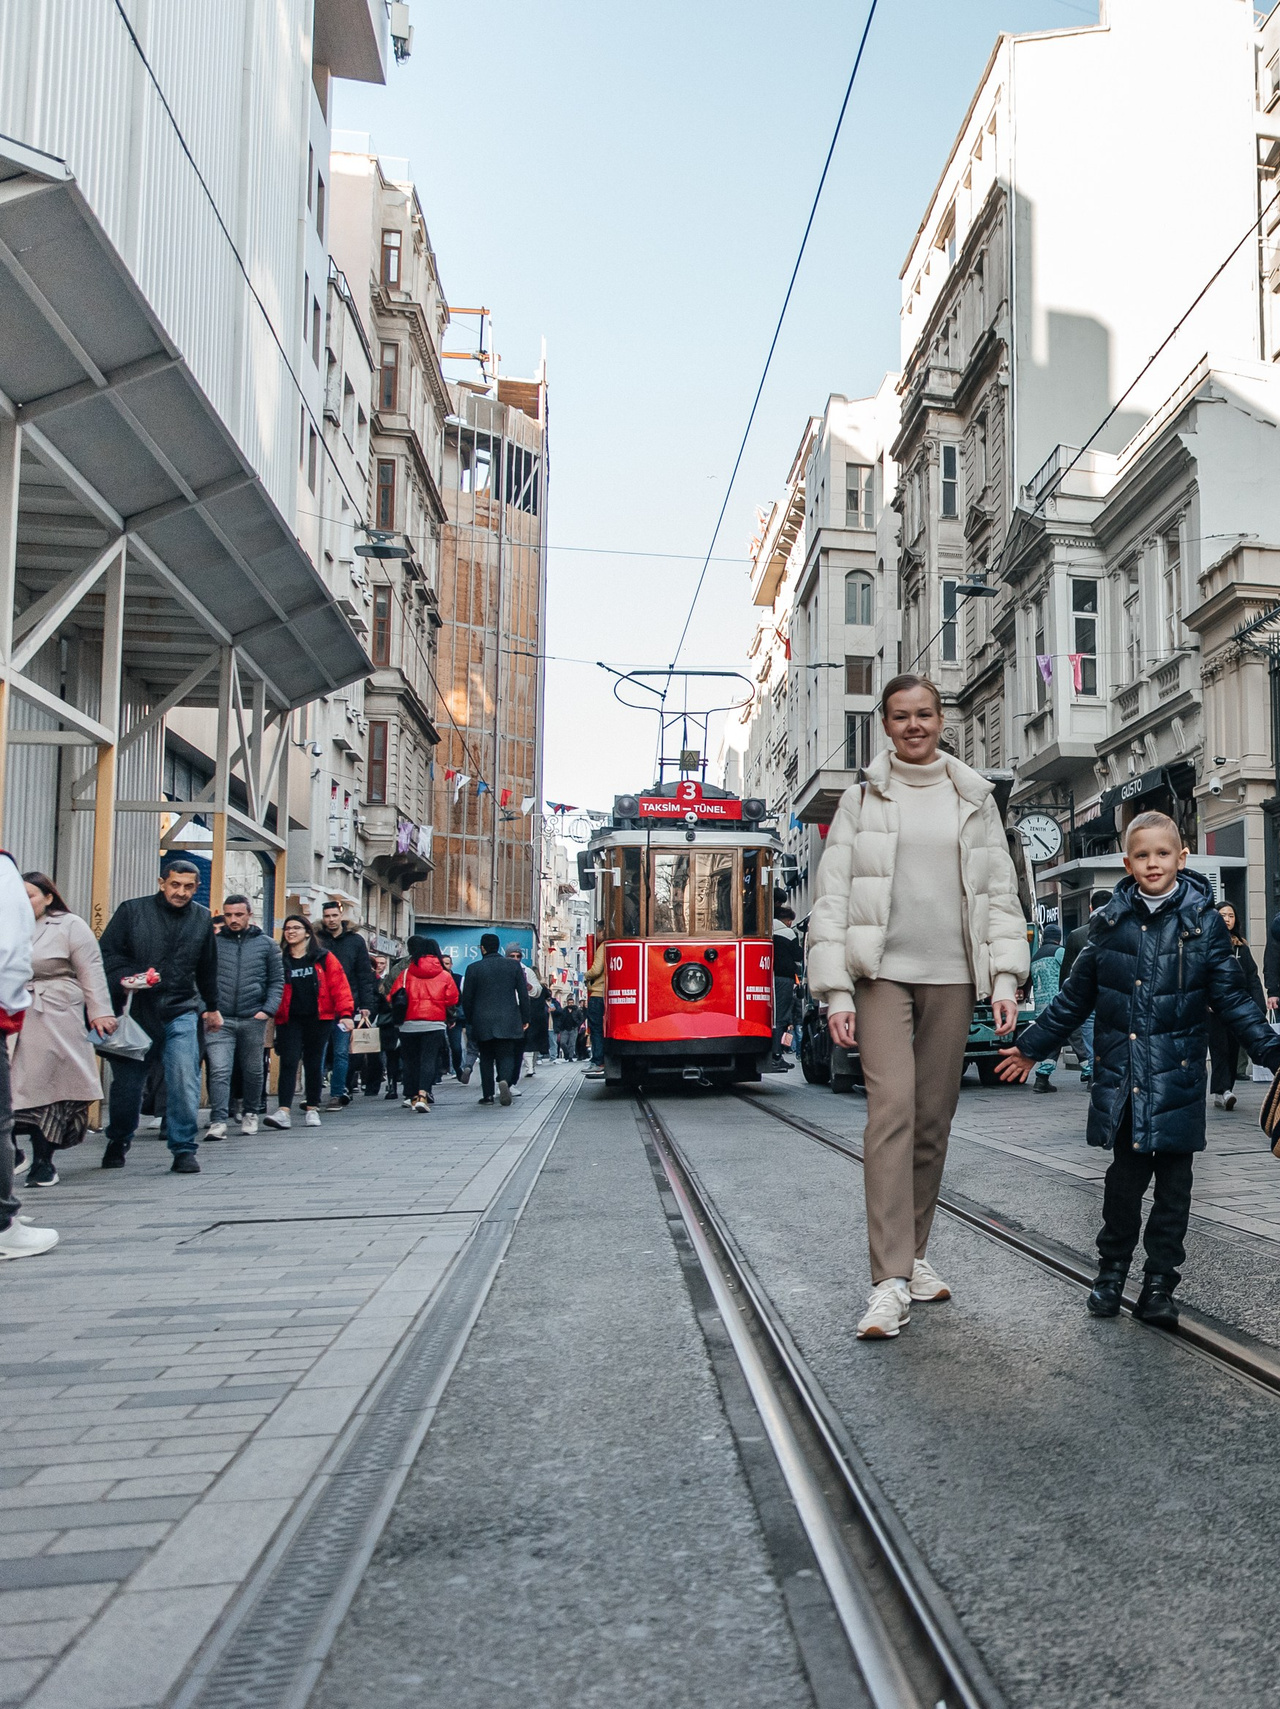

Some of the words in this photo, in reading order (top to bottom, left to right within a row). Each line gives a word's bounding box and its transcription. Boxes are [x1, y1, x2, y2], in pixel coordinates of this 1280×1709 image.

[682, 781, 696, 800] 3
[1121, 778, 1143, 800] GUSTO
[642, 802, 680, 812] TAKSİM
[693, 803, 726, 814] TÜNEL
[610, 956, 623, 971] 410
[759, 955, 770, 970] 410
